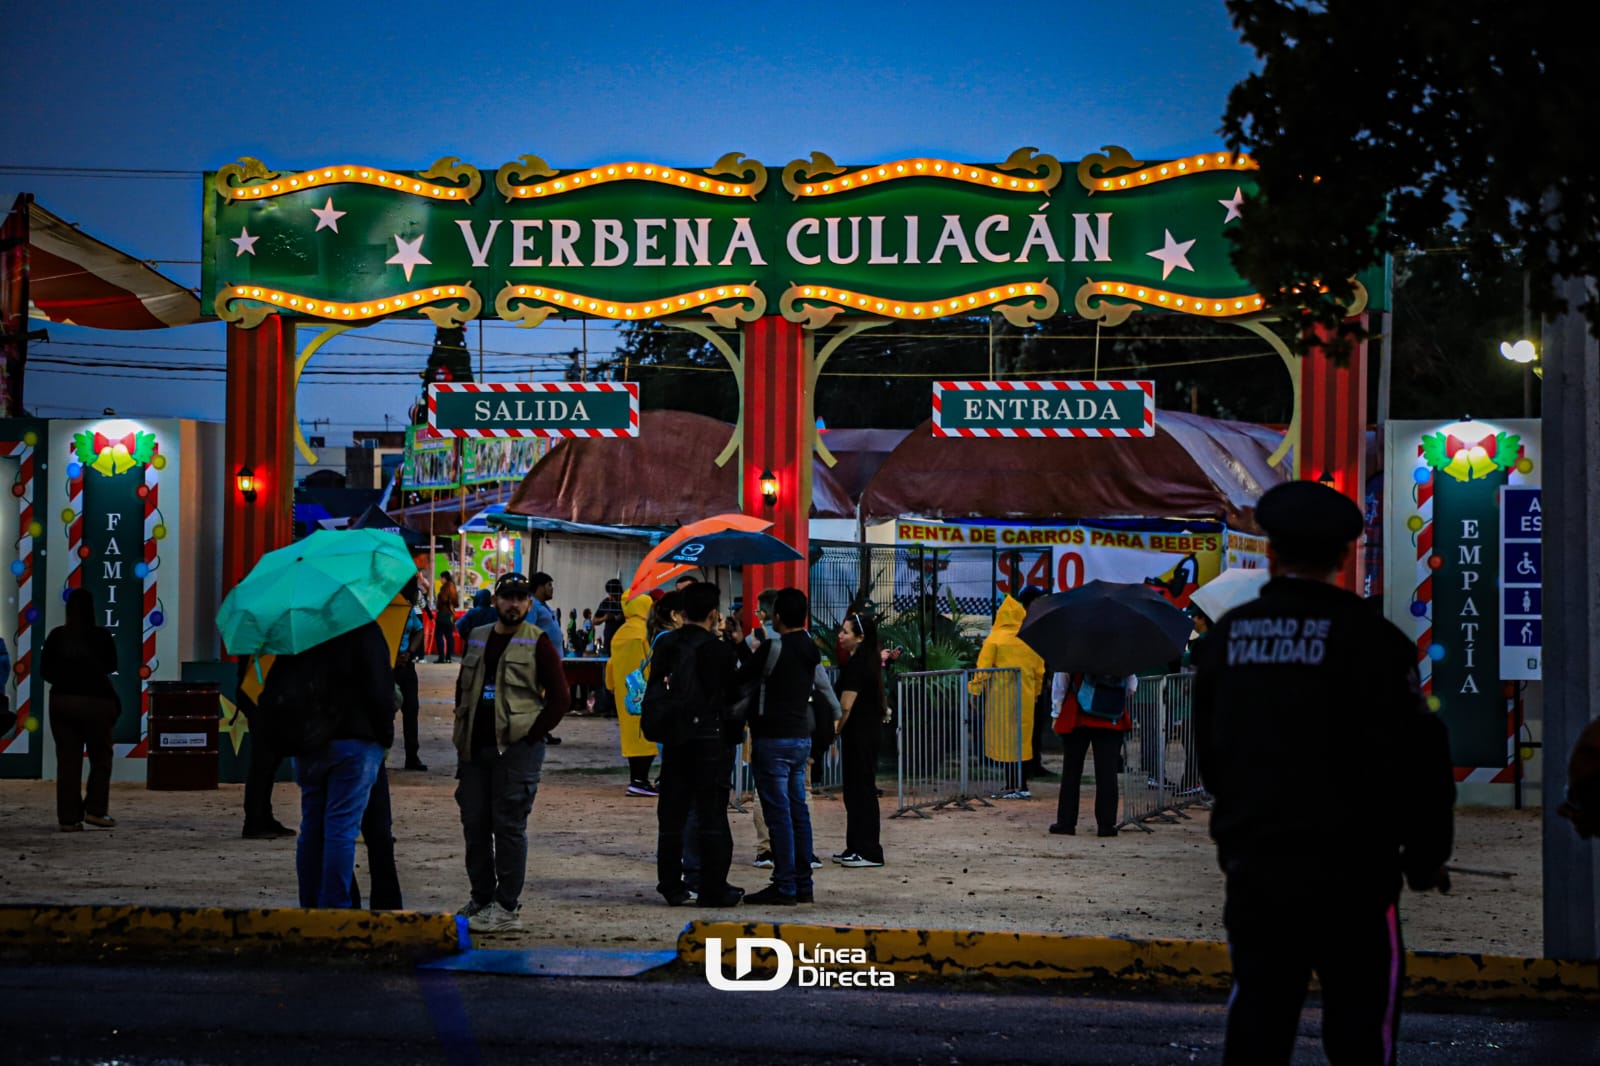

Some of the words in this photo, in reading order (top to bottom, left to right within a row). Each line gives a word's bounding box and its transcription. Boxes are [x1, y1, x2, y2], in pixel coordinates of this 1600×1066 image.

[454, 217, 768, 267] VERBENA
[785, 201, 1113, 265] CULIACÁN
[473, 399, 591, 422] SALIDA
[963, 397, 1121, 421] ENTRADA
[899, 524, 964, 542] RENTA
[970, 527, 995, 543] DE
[1002, 529, 1084, 545] CARROS
[1091, 531, 1144, 549] PARA
[1150, 536, 1217, 552] BEBES
[996, 550, 1085, 594] $40
[102, 512, 123, 675] FAMIL
[1457, 519, 1482, 695] EMPATÍA
[1229, 617, 1299, 640] UNIDAD
[1301, 618, 1332, 640] DE
[1226, 637, 1326, 668] VIALIDAD
